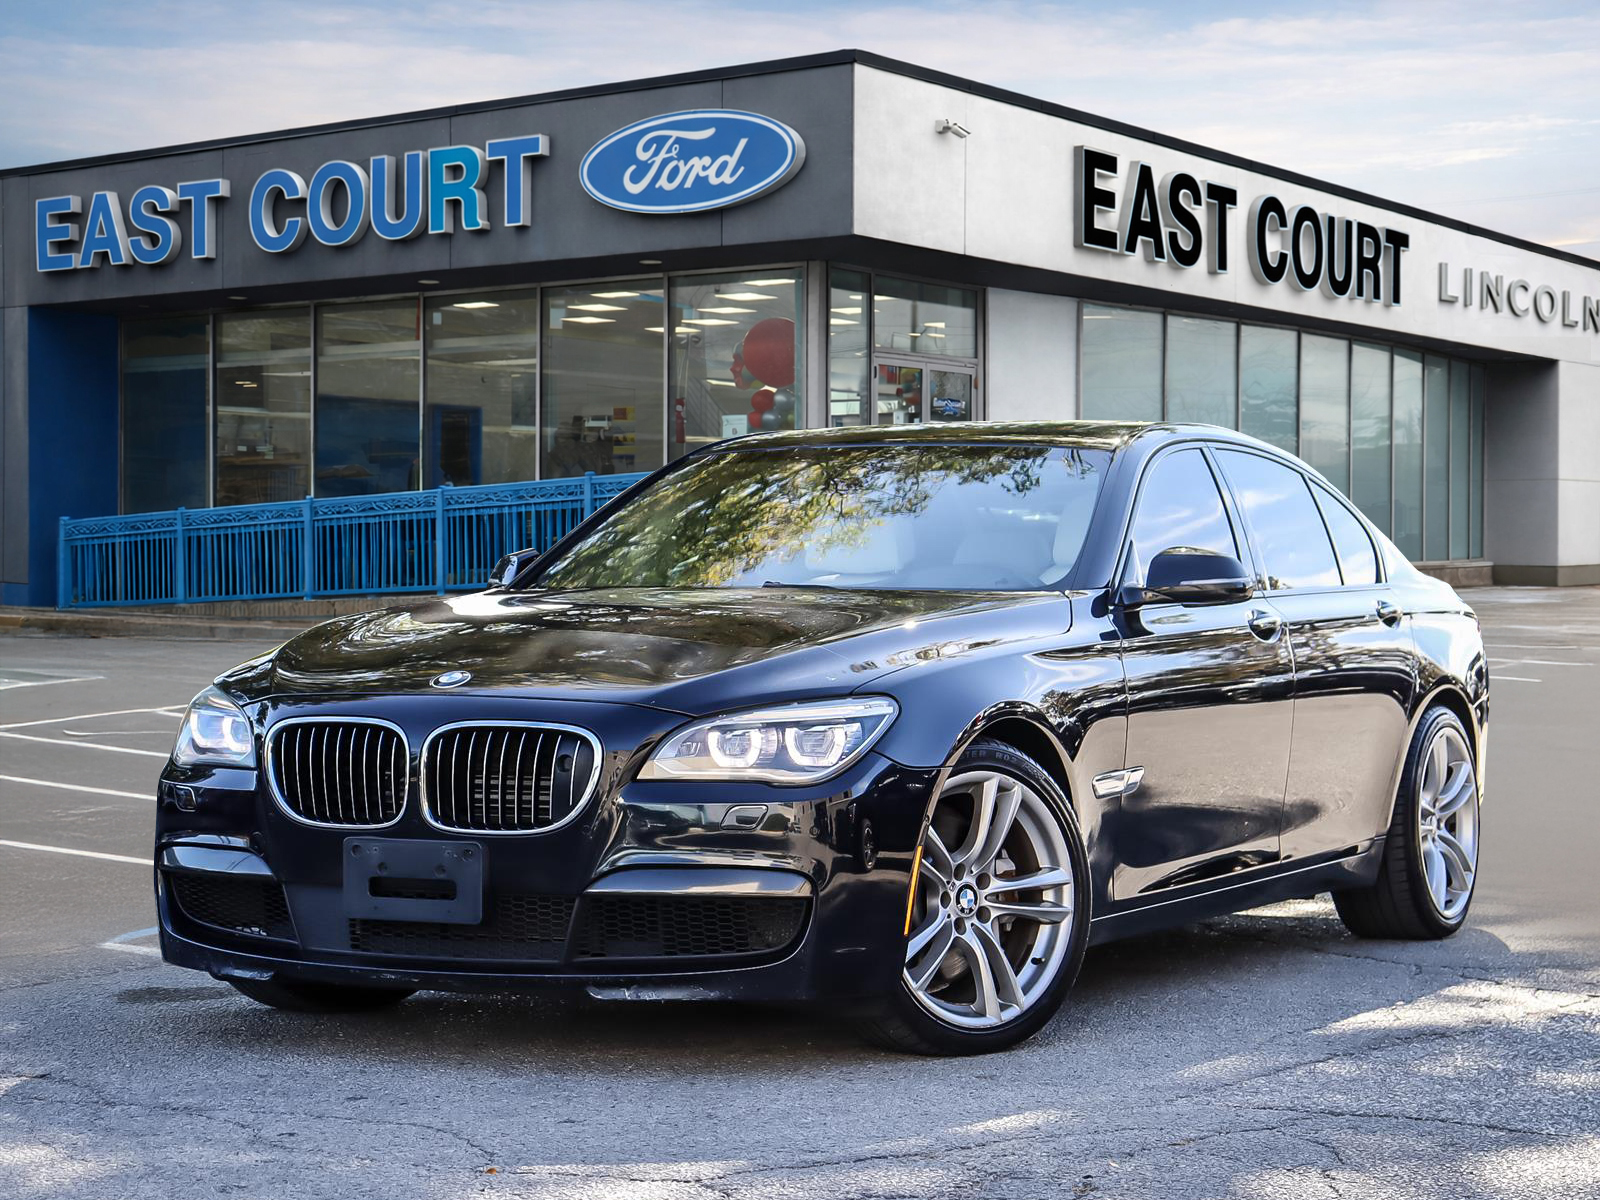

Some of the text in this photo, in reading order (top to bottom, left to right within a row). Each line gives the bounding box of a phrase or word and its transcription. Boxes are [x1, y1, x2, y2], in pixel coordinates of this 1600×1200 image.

[36, 134, 550, 272] EAST COURT
[623, 127, 748, 194] Ford
[1074, 145, 1410, 307] EAST COURT
[1438, 262, 1600, 334] LINCOLN
